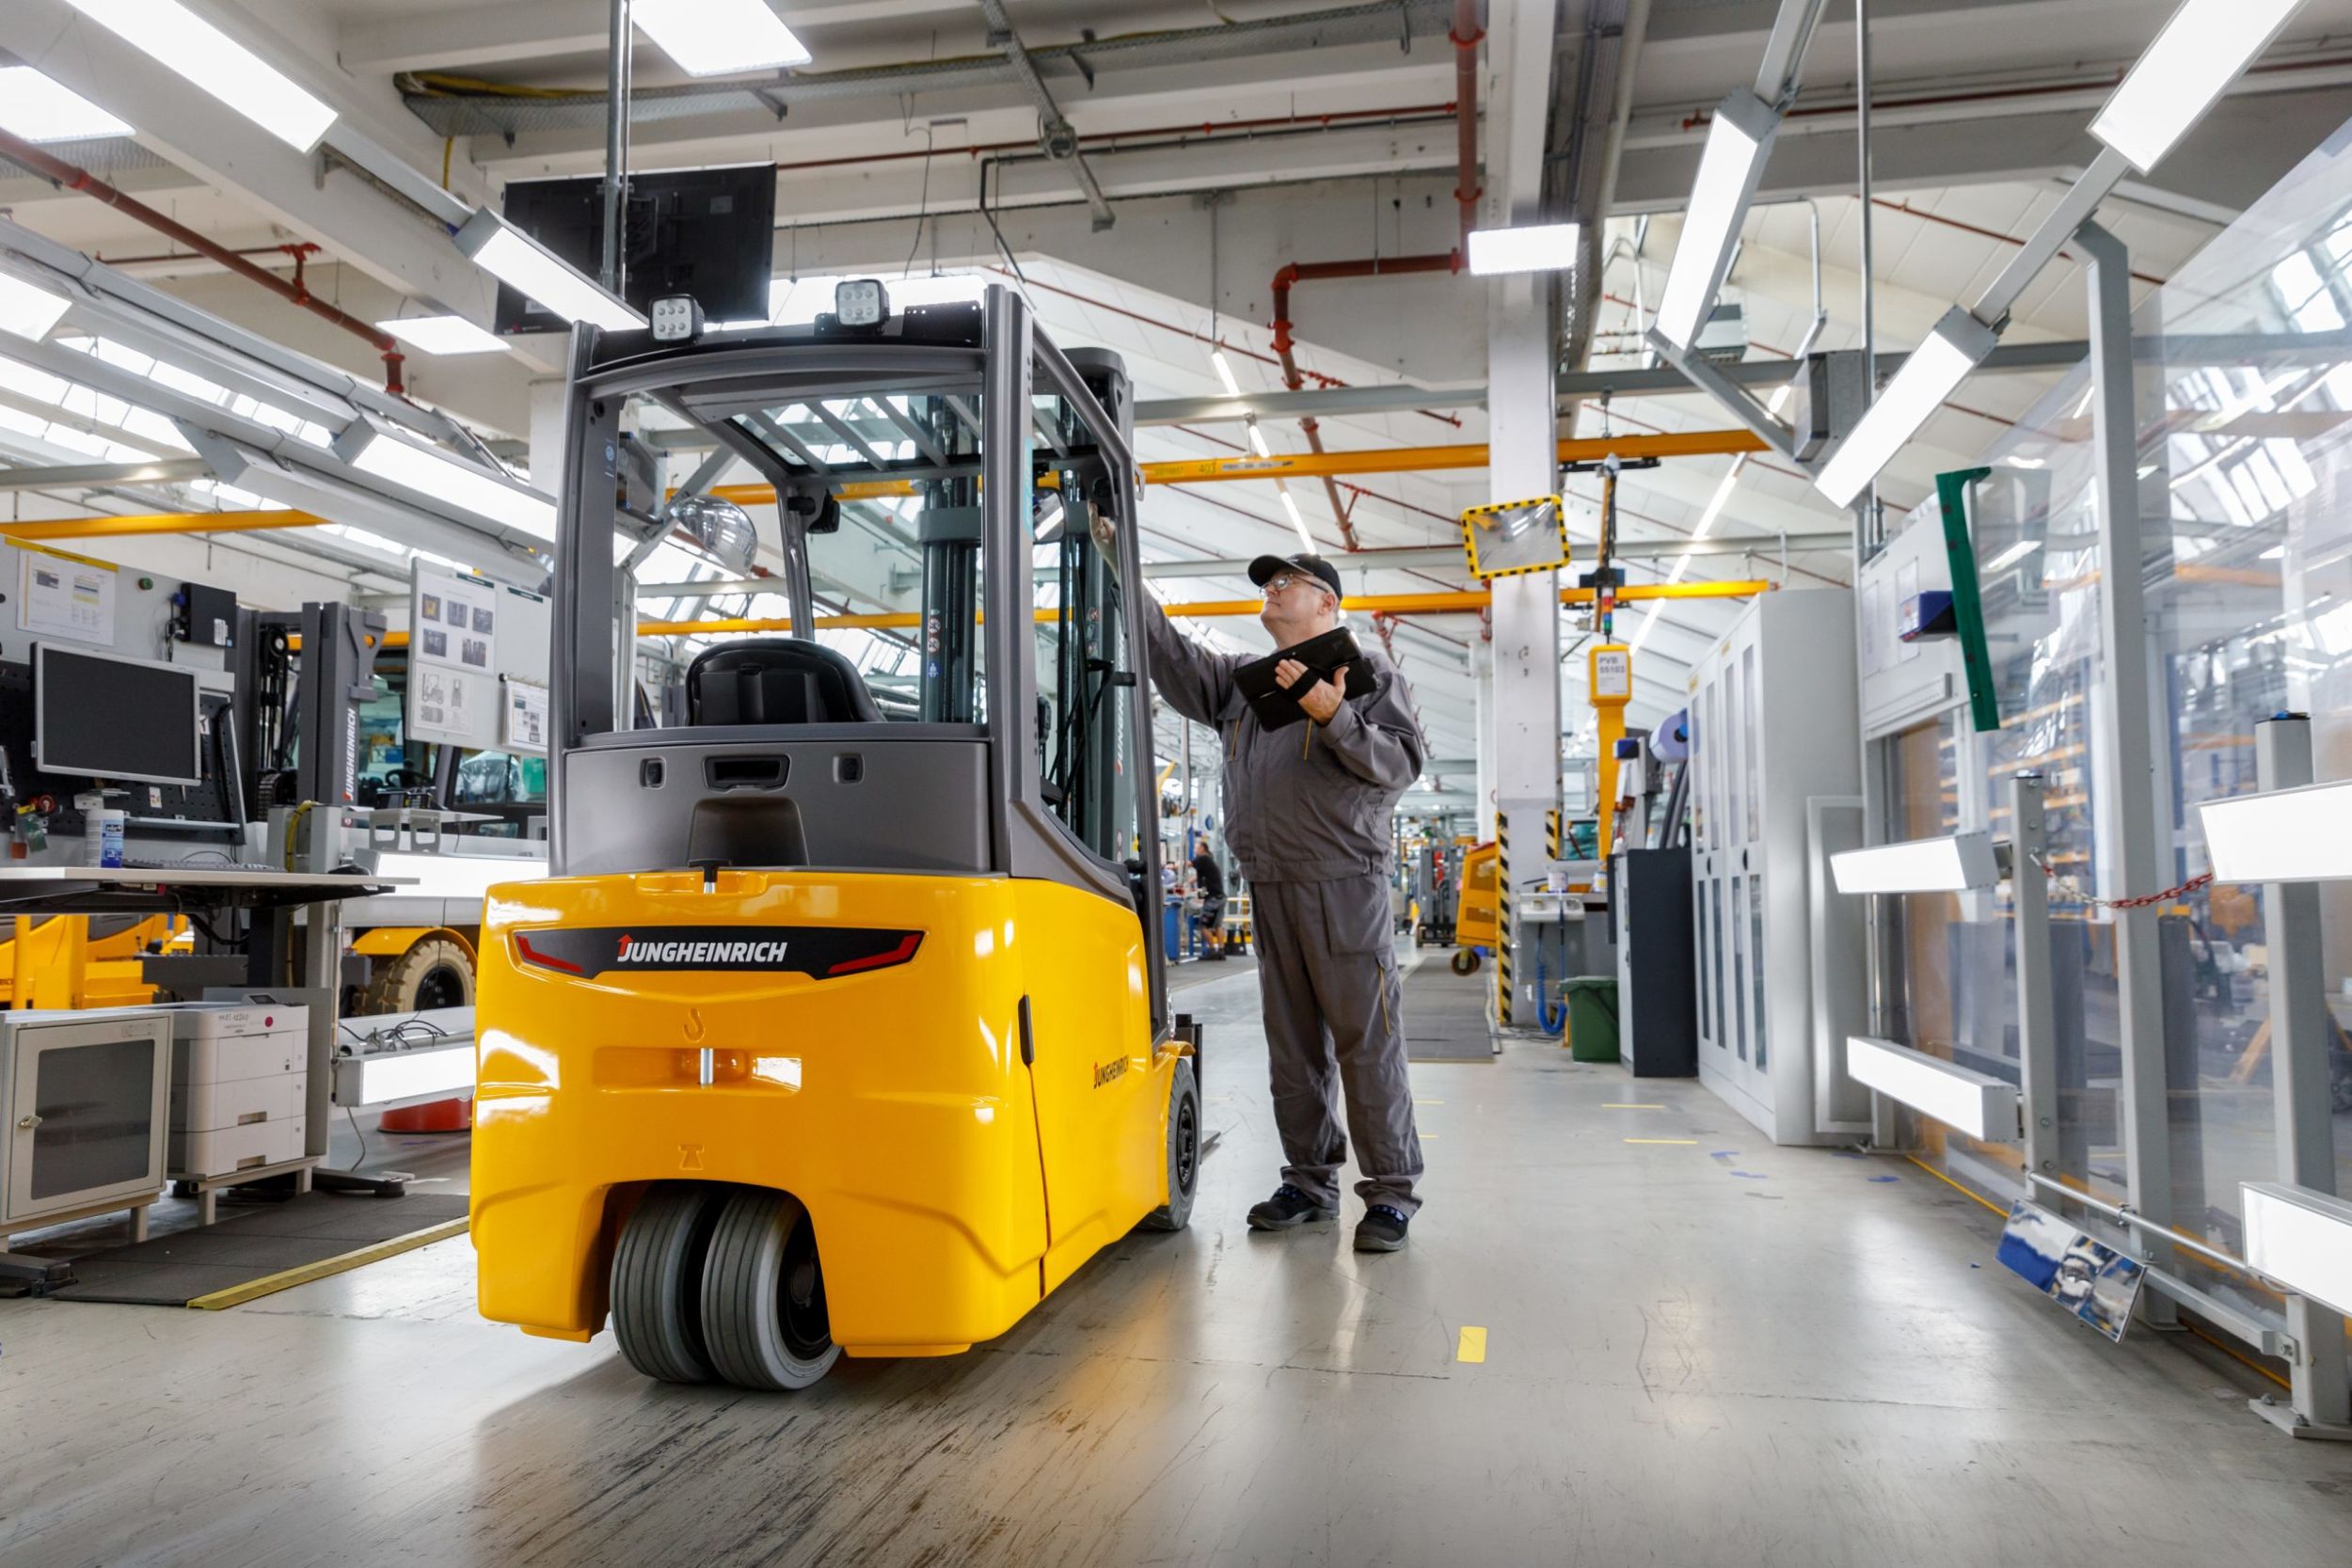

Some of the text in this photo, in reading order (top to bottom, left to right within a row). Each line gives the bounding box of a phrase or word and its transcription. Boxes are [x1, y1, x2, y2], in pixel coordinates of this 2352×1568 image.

[343, 707, 356, 801] JUNGHEINRICH
[617, 936, 787, 962] JUNGHEINRICH
[1093, 1053, 1129, 1089] JUNGHEINRICH
